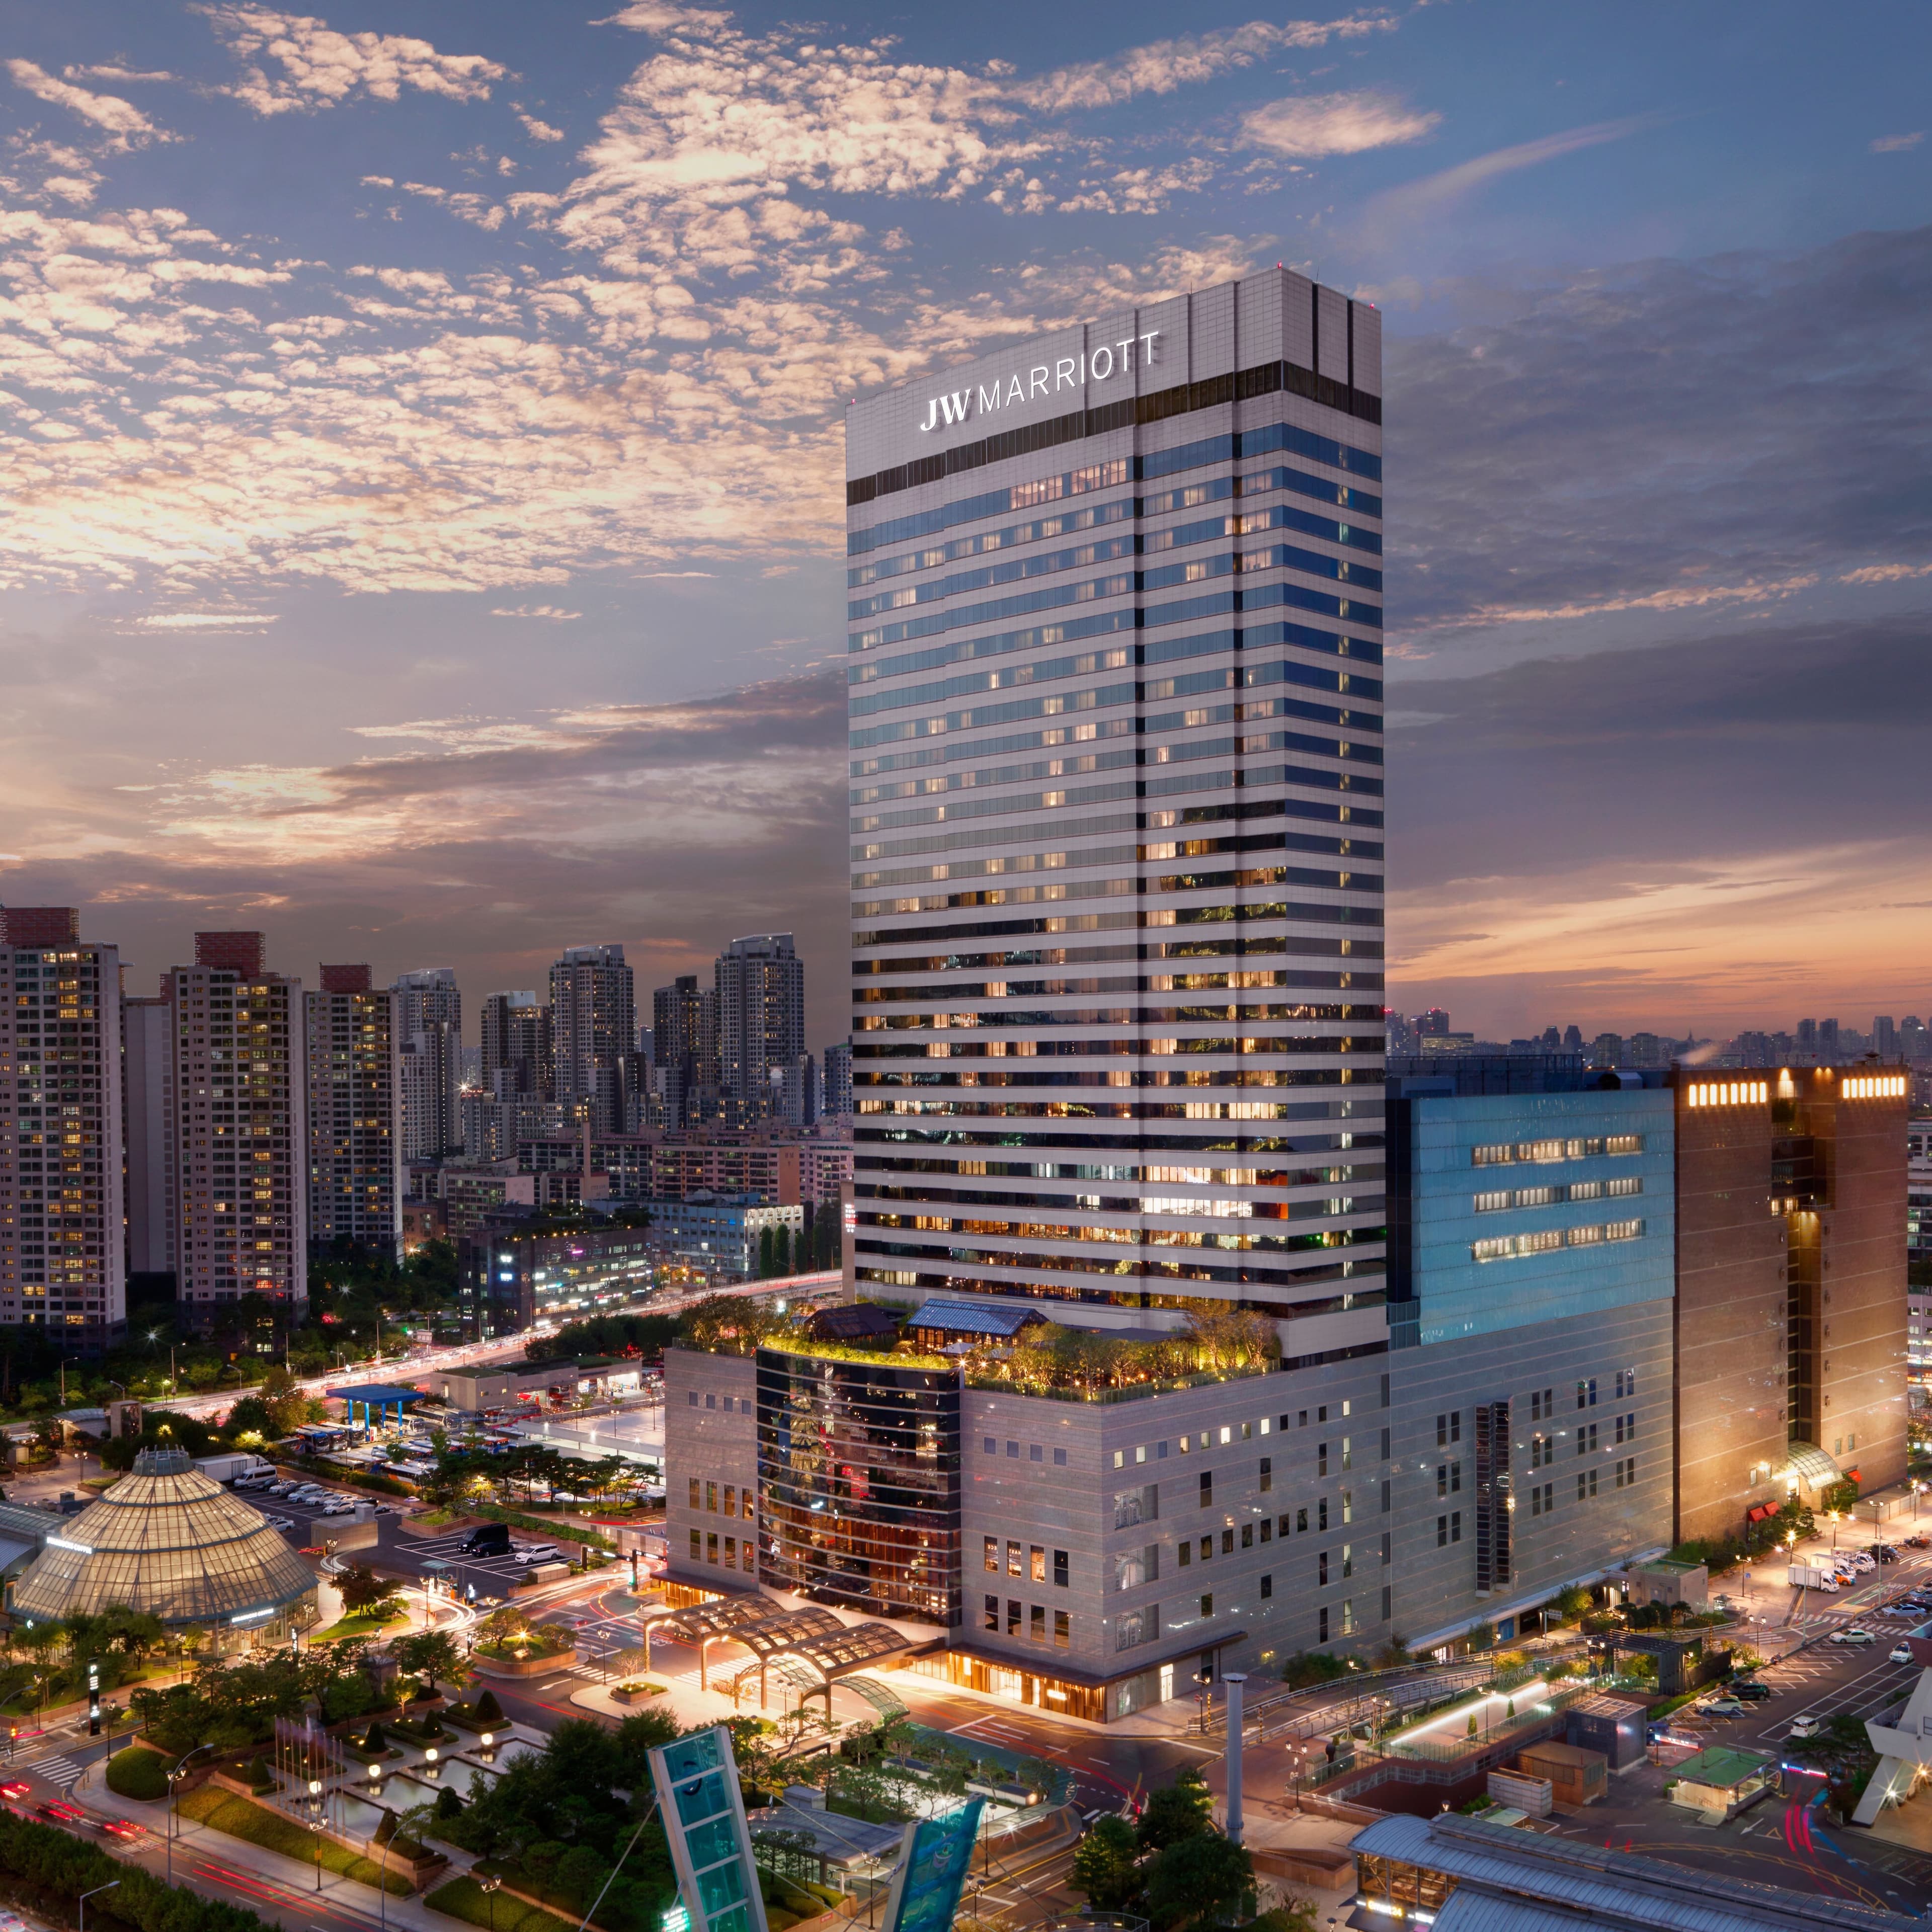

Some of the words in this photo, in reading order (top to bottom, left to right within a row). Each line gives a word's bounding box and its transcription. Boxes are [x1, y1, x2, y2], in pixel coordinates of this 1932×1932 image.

[920, 388, 972, 431] JW
[979, 331, 1159, 415] MARRIOTT
[91, 1665, 97, 1673] P
